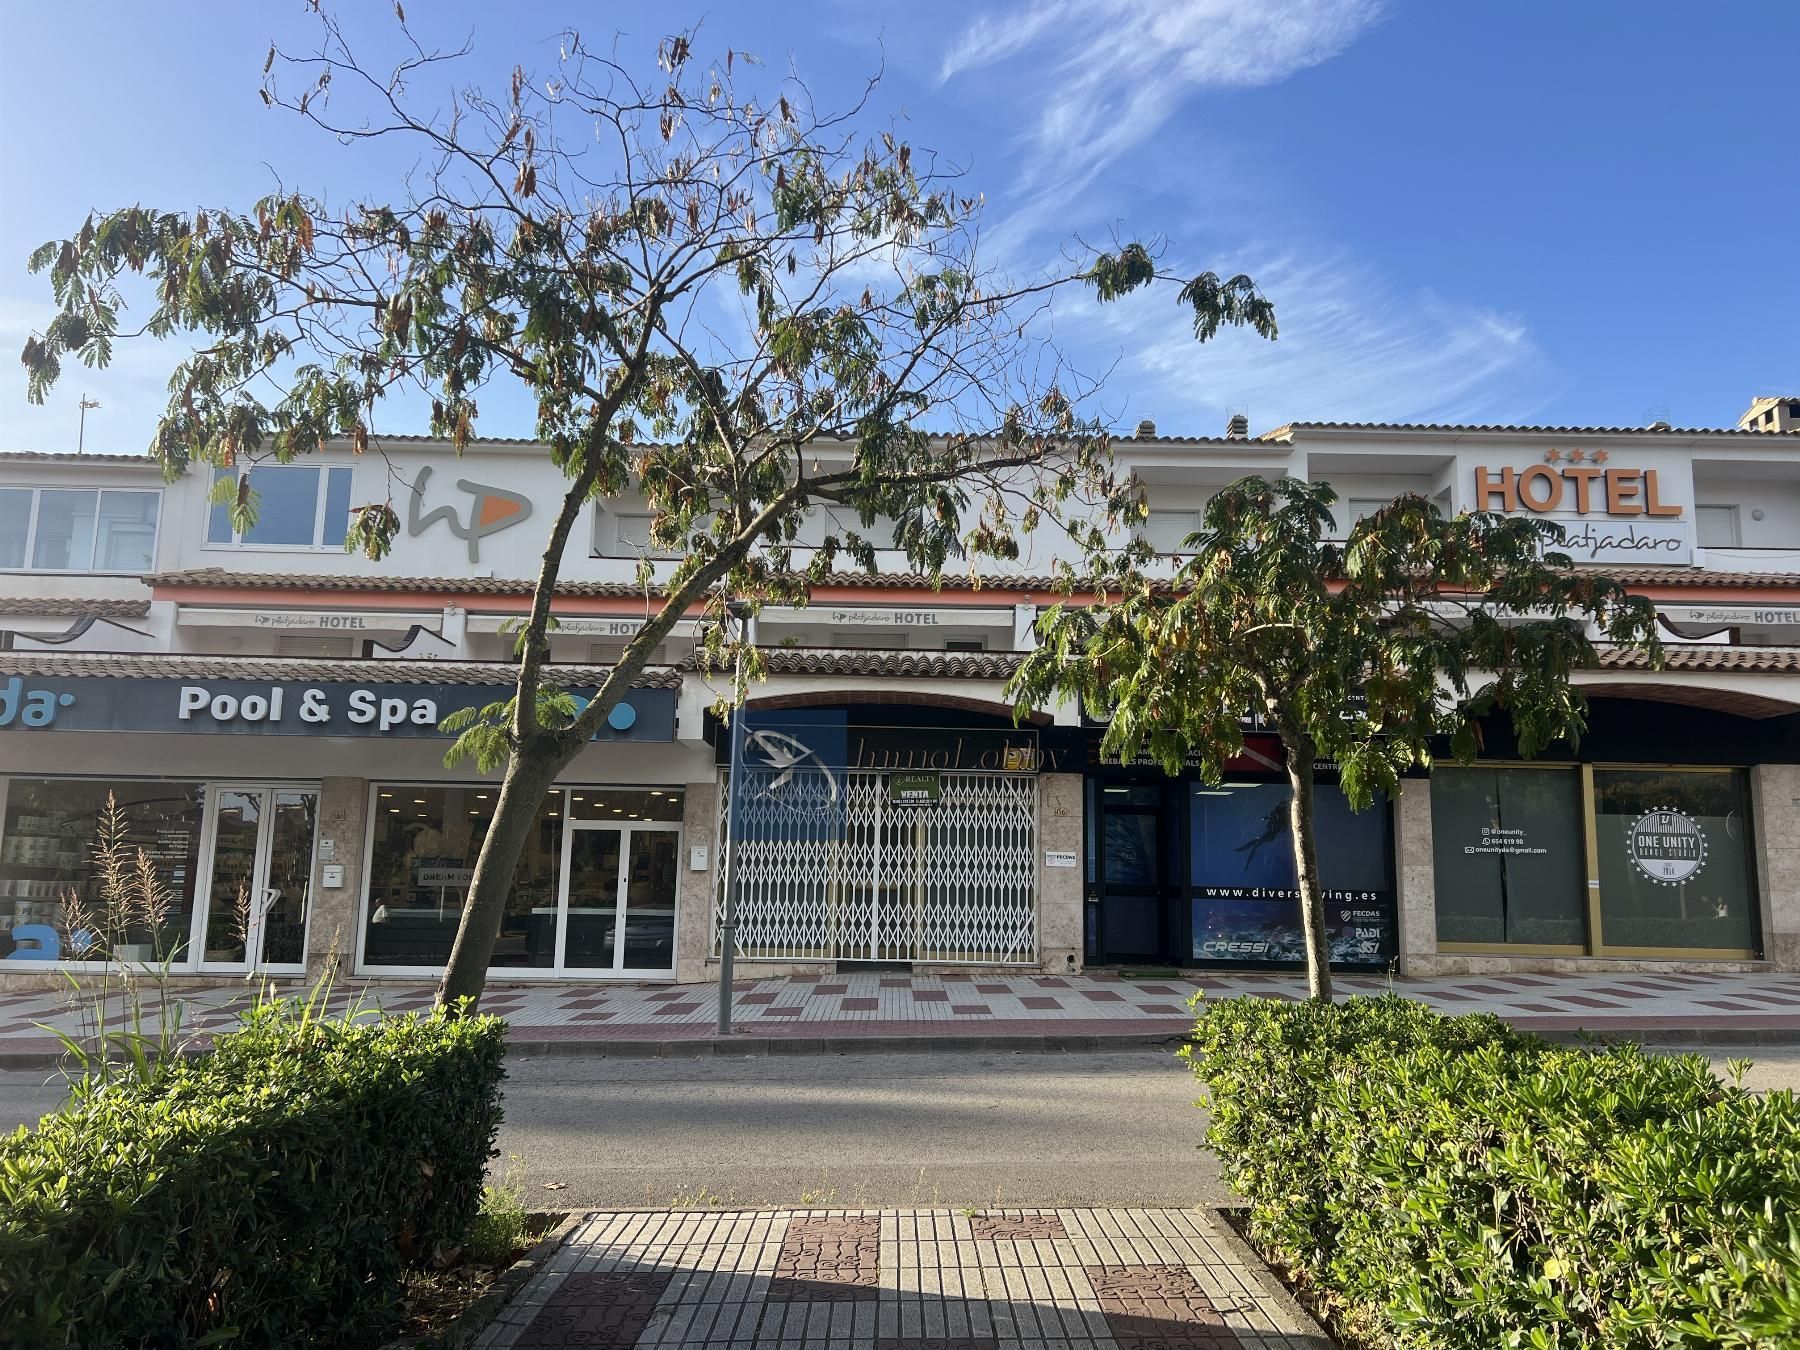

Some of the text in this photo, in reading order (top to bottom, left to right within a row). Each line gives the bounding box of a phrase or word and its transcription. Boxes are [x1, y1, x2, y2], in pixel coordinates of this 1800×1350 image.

[1475, 464, 1684, 516] HOTEL
[319, 616, 366, 628] HOTEL
[894, 612, 939, 624] HOTEL
[1754, 611, 1800, 623] HOTEL
[609, 623, 643, 635] HOT
[178, 686, 438, 731] Pool & Spa
[901, 791, 929, 799] VENTA
[1638, 836, 1695, 848] ONE UNITY
[423, 873, 455, 881] DREAM
[1355, 927, 1380, 938] PADI
[1203, 941, 1269, 953] CRESSI
